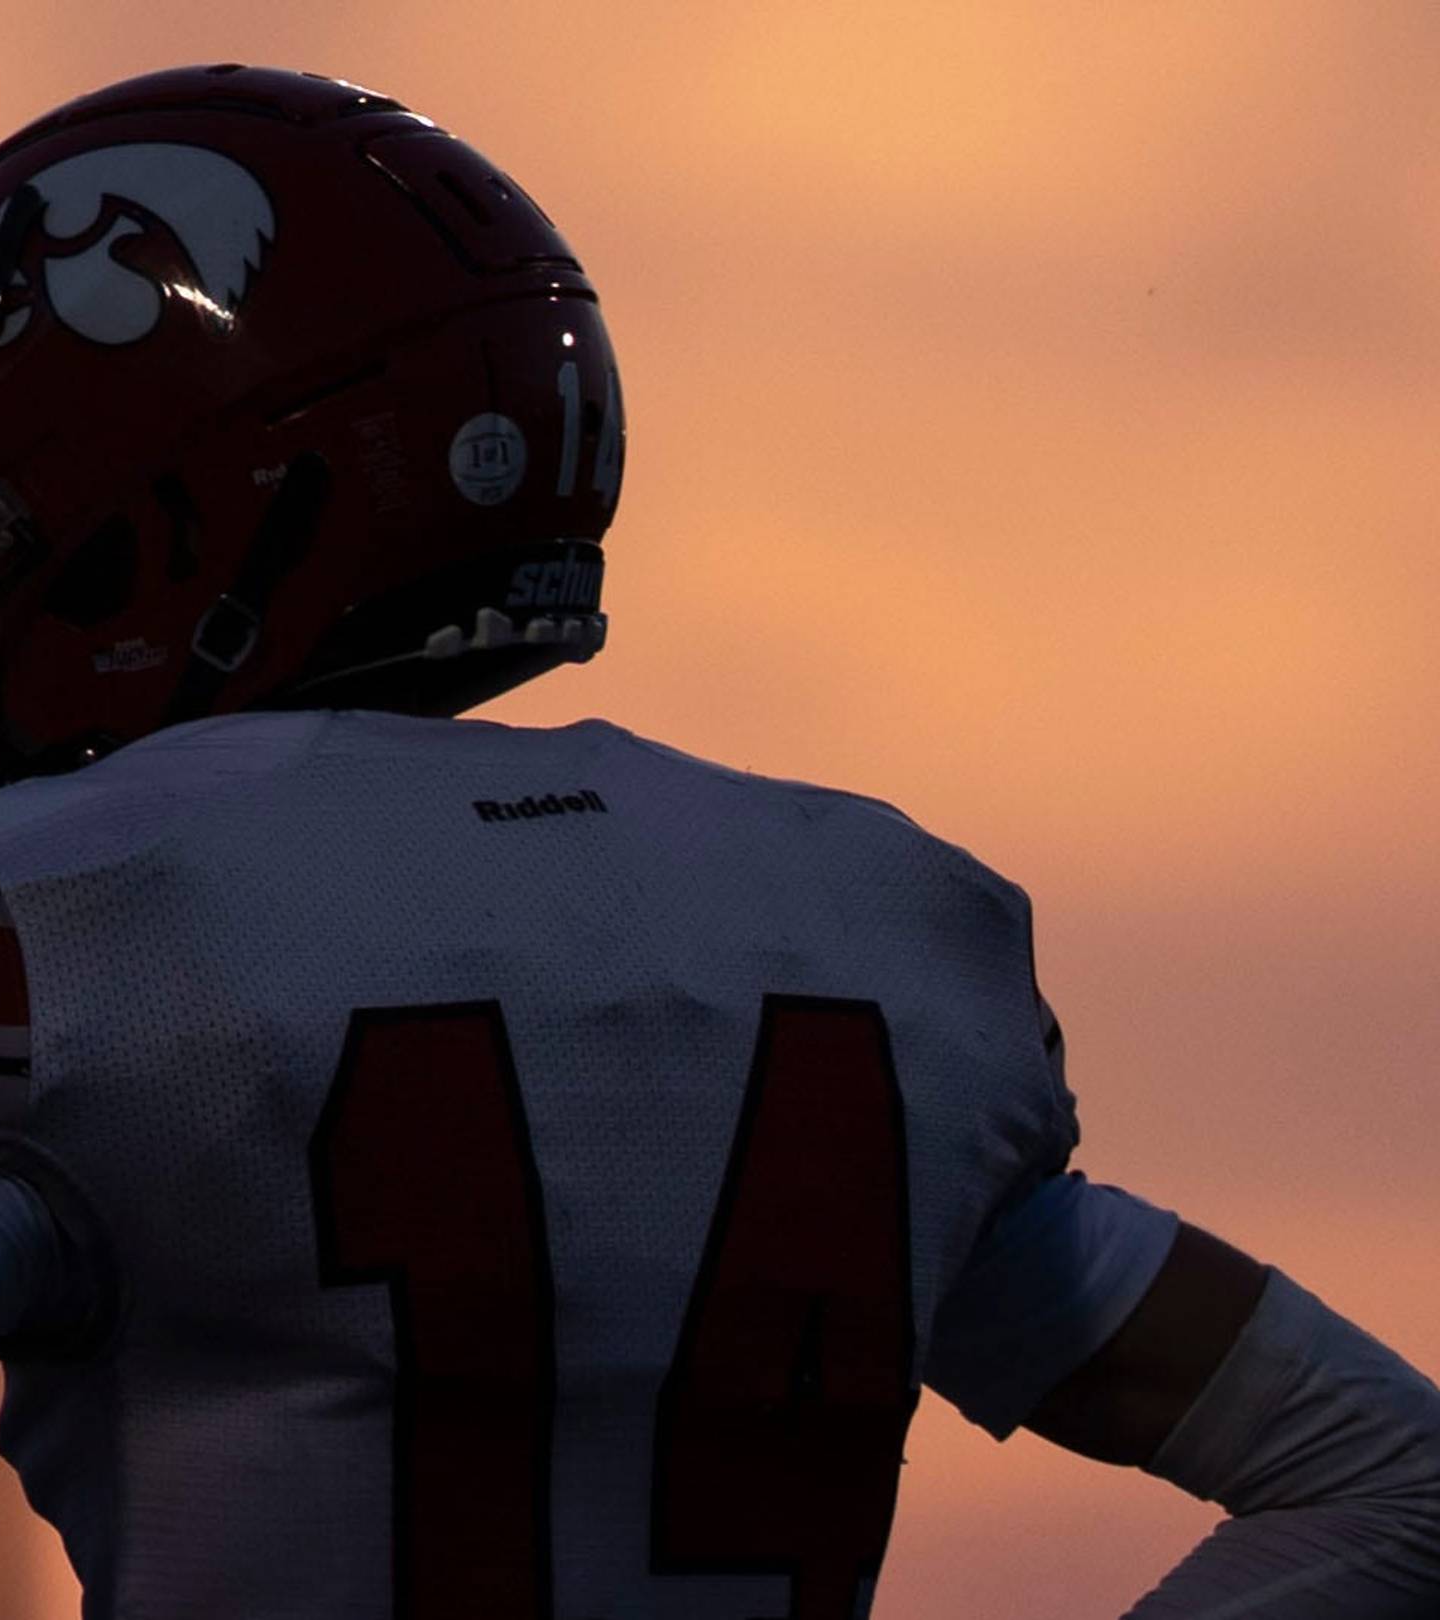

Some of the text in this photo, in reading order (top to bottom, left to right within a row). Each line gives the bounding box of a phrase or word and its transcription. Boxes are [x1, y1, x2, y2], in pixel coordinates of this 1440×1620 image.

[504, 546, 602, 609] schu
[472, 789, 607, 822] Riddell
[309, 994, 916, 1620] 14
